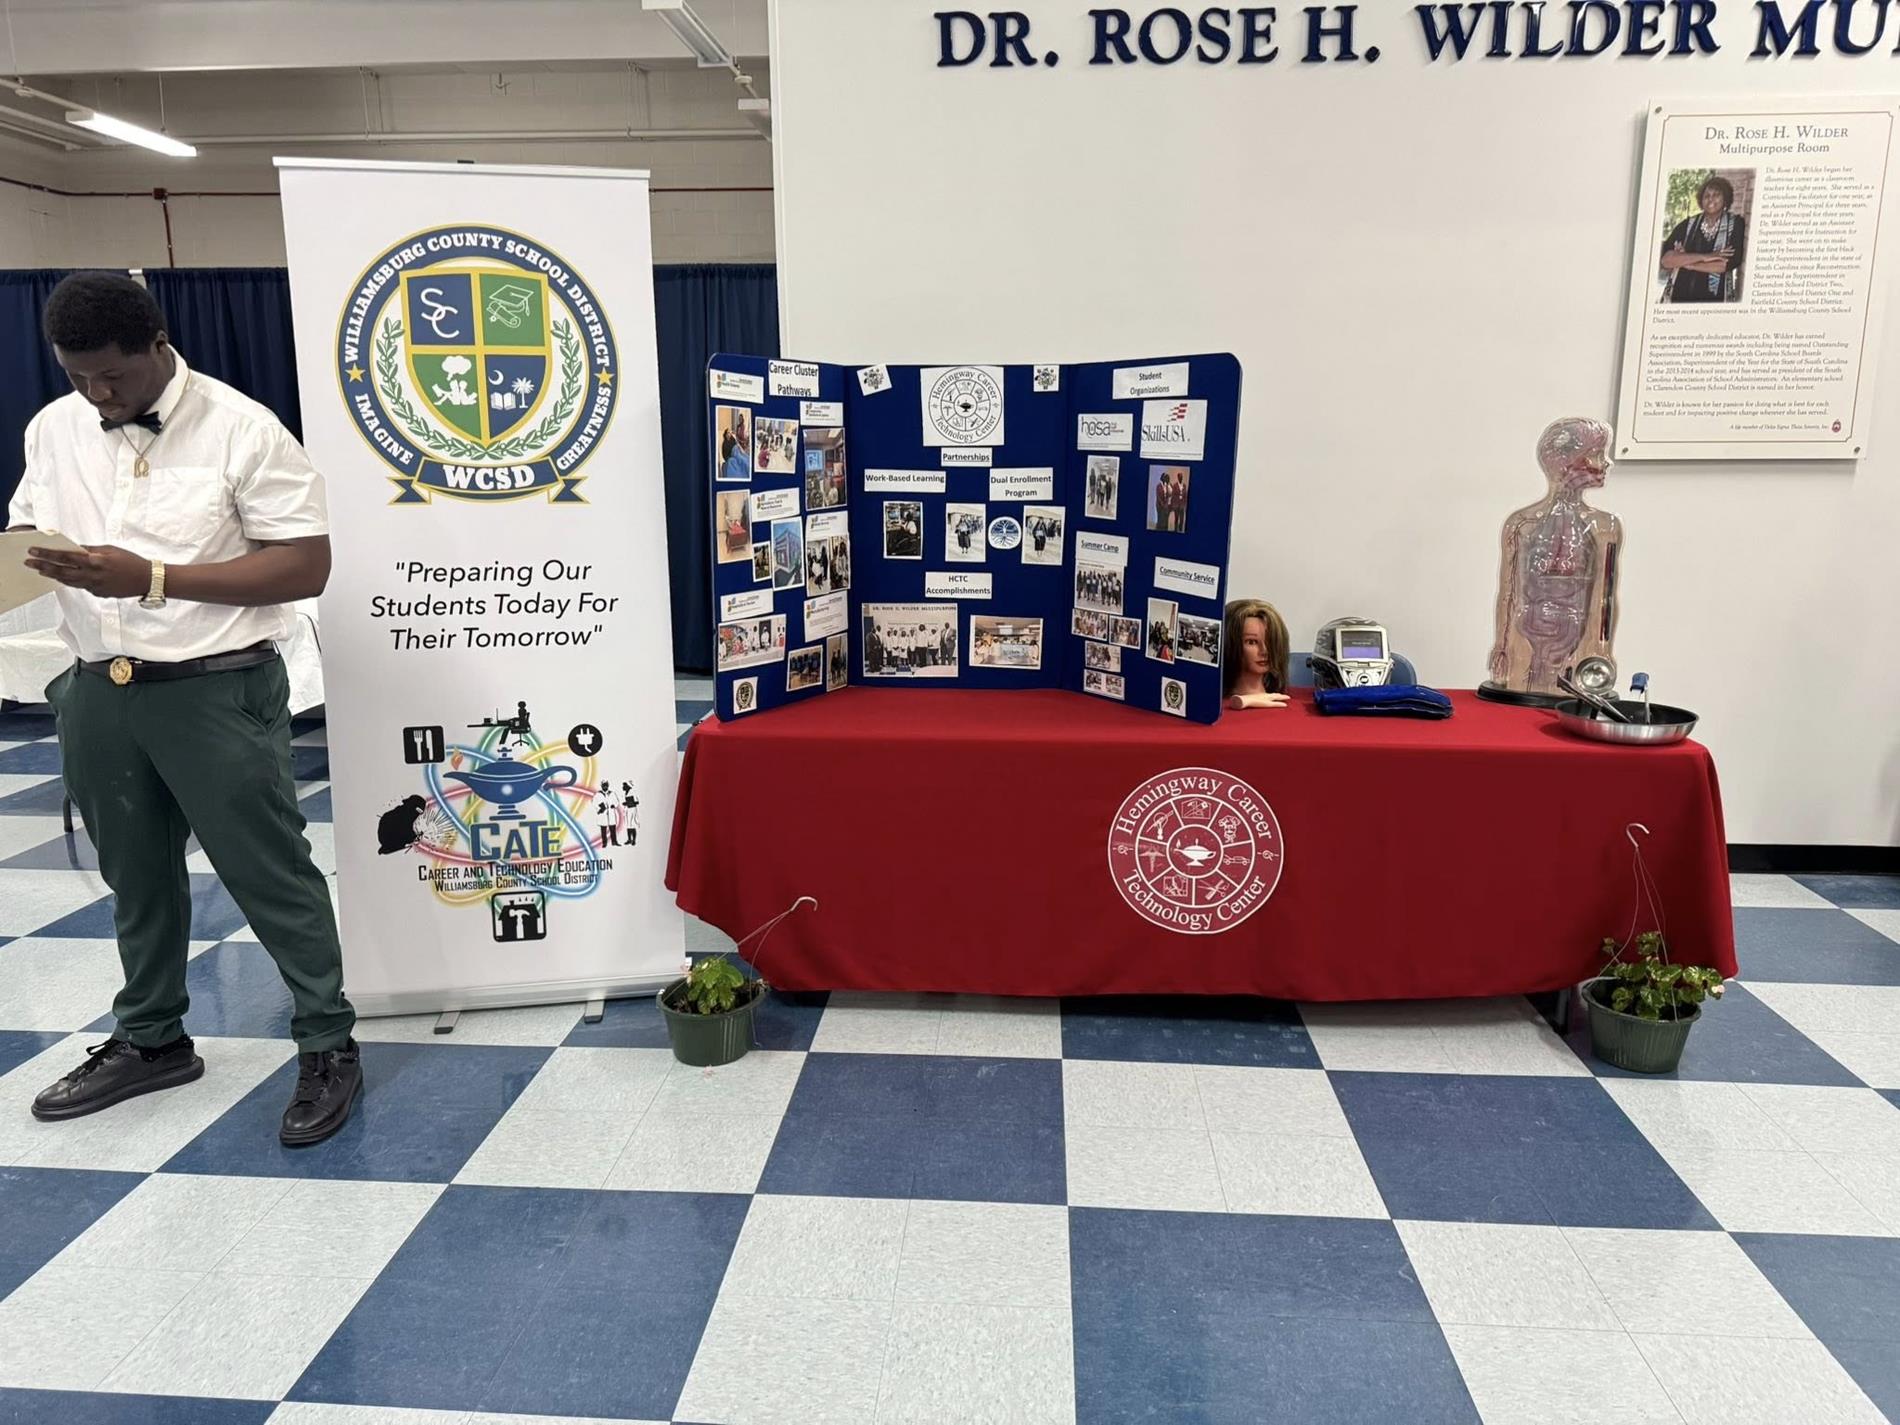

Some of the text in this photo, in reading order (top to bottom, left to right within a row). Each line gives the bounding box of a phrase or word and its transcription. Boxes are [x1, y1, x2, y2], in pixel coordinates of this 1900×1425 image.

[935, 0, 1900, 67] DR. ROSE H. WILDER MU
[1705, 125, 1849, 140] DR. ROSE H. WILDER
[1719, 142, 1830, 155] Multipurpose Room
[345, 233, 610, 366] WILLIAMSBURG COUNTY SCHOOL DISTRICT
[769, 361, 818, 377] Career Cluster
[1138, 372, 1162, 381] Student
[777, 384, 811, 397] Pathways
[931, 369, 997, 400] Hemingway Career
[1130, 386, 1170, 396] Organizations
[355, 385, 611, 470] IMAGINE GREATNESS
[935, 414, 997, 441] Technology Center
[1081, 416, 1111, 437] hosa
[942, 453, 990, 462] Partnerships
[443, 464, 536, 491] WCSD
[865, 474, 945, 484] Work-Based Learning
[990, 475, 1052, 484] Dual Enrollment
[1004, 489, 1038, 499] Program
[1081, 540, 1120, 554] Summer Camp
[395, 559, 592, 588] "Preparing Our
[948, 575, 969, 583] HCTC
[1160, 566, 1216, 584] Community Service
[926, 587, 991, 596] Accomplishments
[370, 592, 619, 619] Students Today For
[390, 624, 603, 650] Their Tomorrow"
[1116, 776, 1272, 839] Hemingway Career
[470, 820, 562, 861] CATE
[418, 858, 613, 881] CAREER AND TECHNOLOGY EDUCATION
[434, 872, 599, 891] WILLIAMSBURG COUNTY SCHOOL DISTRICT
[1123, 869, 1267, 931] Technology Center
